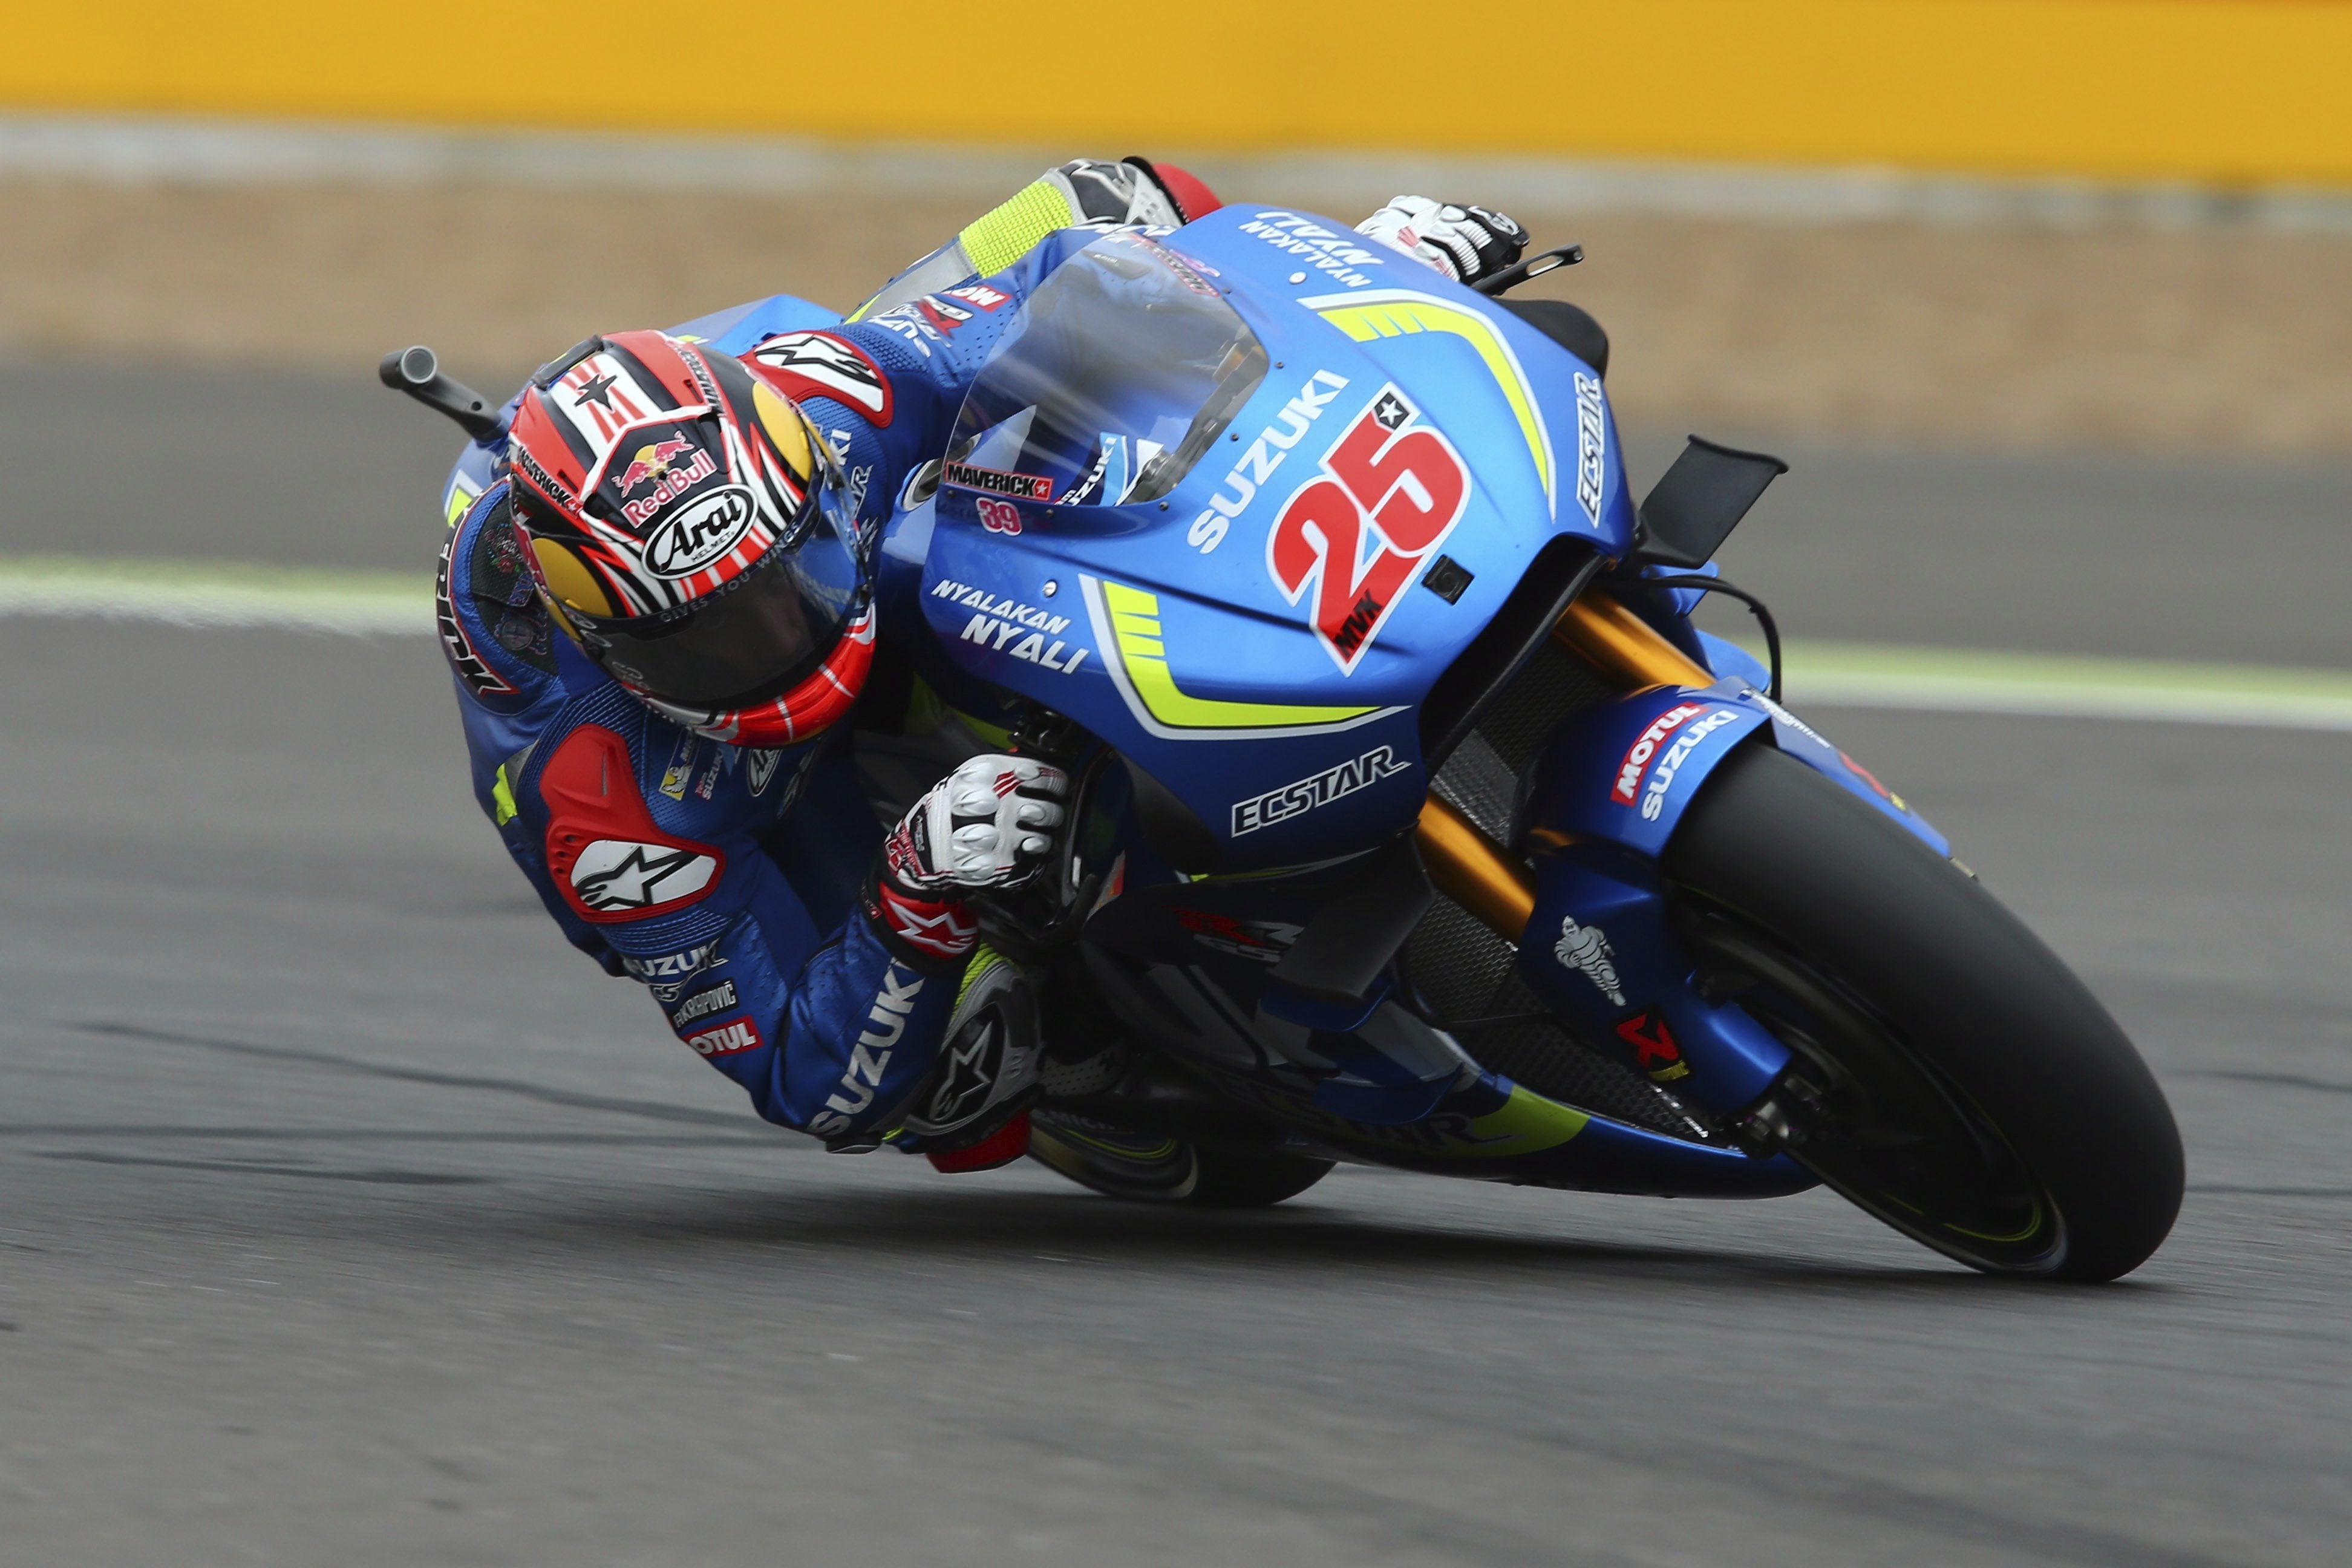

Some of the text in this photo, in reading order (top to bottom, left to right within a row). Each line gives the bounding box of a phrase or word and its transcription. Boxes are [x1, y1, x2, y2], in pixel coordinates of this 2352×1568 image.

[1238, 220, 1373, 288] NYALAKAN
[621, 448, 717, 529] Red Bull
[948, 464, 1036, 497] MAVERICK
[1187, 369, 1350, 555] SUZUKI
[1574, 371, 1604, 529] ECSTAR
[659, 491, 743, 573] Arai
[976, 497, 1022, 537] 39
[1266, 382, 1472, 677] 25
[659, 520, 801, 622] GIVES YOU WINGS
[931, 579, 1071, 635] NYALAKAN
[960, 613, 1089, 675] NYALI
[1334, 588, 1383, 657] MVK
[1232, 745, 1413, 838] ECSTAR
[1616, 705, 1701, 800] MOTUL
[1641, 709, 1740, 822] SUZUKI
[689, 1022, 756, 1054] OTUL
[806, 956, 926, 1136] SUZUK
